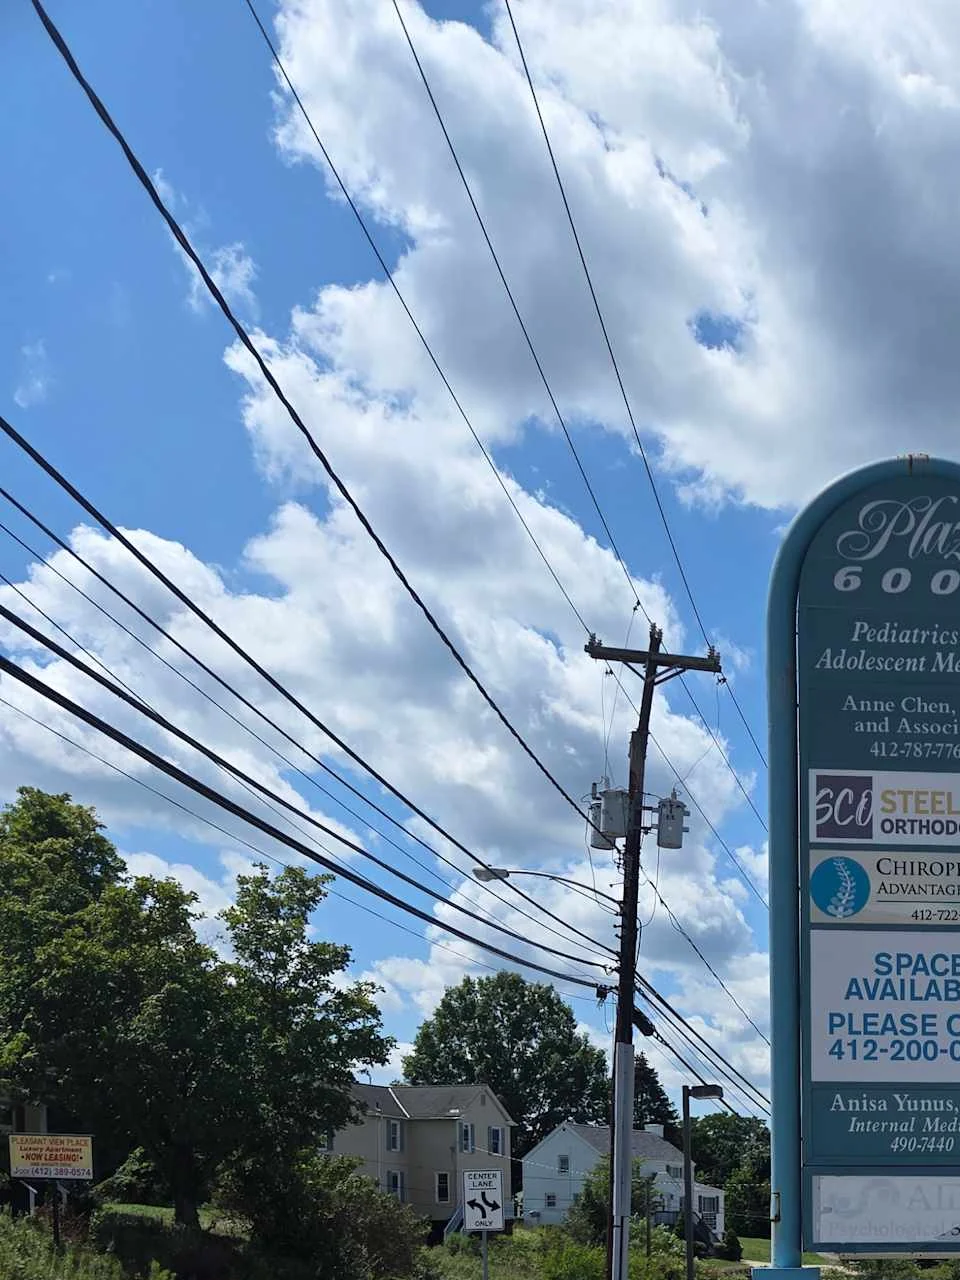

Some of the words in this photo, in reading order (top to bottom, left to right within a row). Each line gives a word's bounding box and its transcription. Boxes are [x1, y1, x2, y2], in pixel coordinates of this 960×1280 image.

[851, 621, 959, 645] Pediatrics
[815, 648, 926, 673] Adolescent
[841, 696, 895, 713] Anne
[901, 697, 956, 716] Chen,
[854, 717, 889, 733] and
[880, 790, 960, 815] STEEL
[828, 1012, 939, 1037] PLEASE
[830, 1094, 888, 1112] Anisa
[893, 1094, 959, 1114] Yunus,
[848, 1117, 915, 1133] Internal
[890, 1137, 955, 1152] 490-7440
